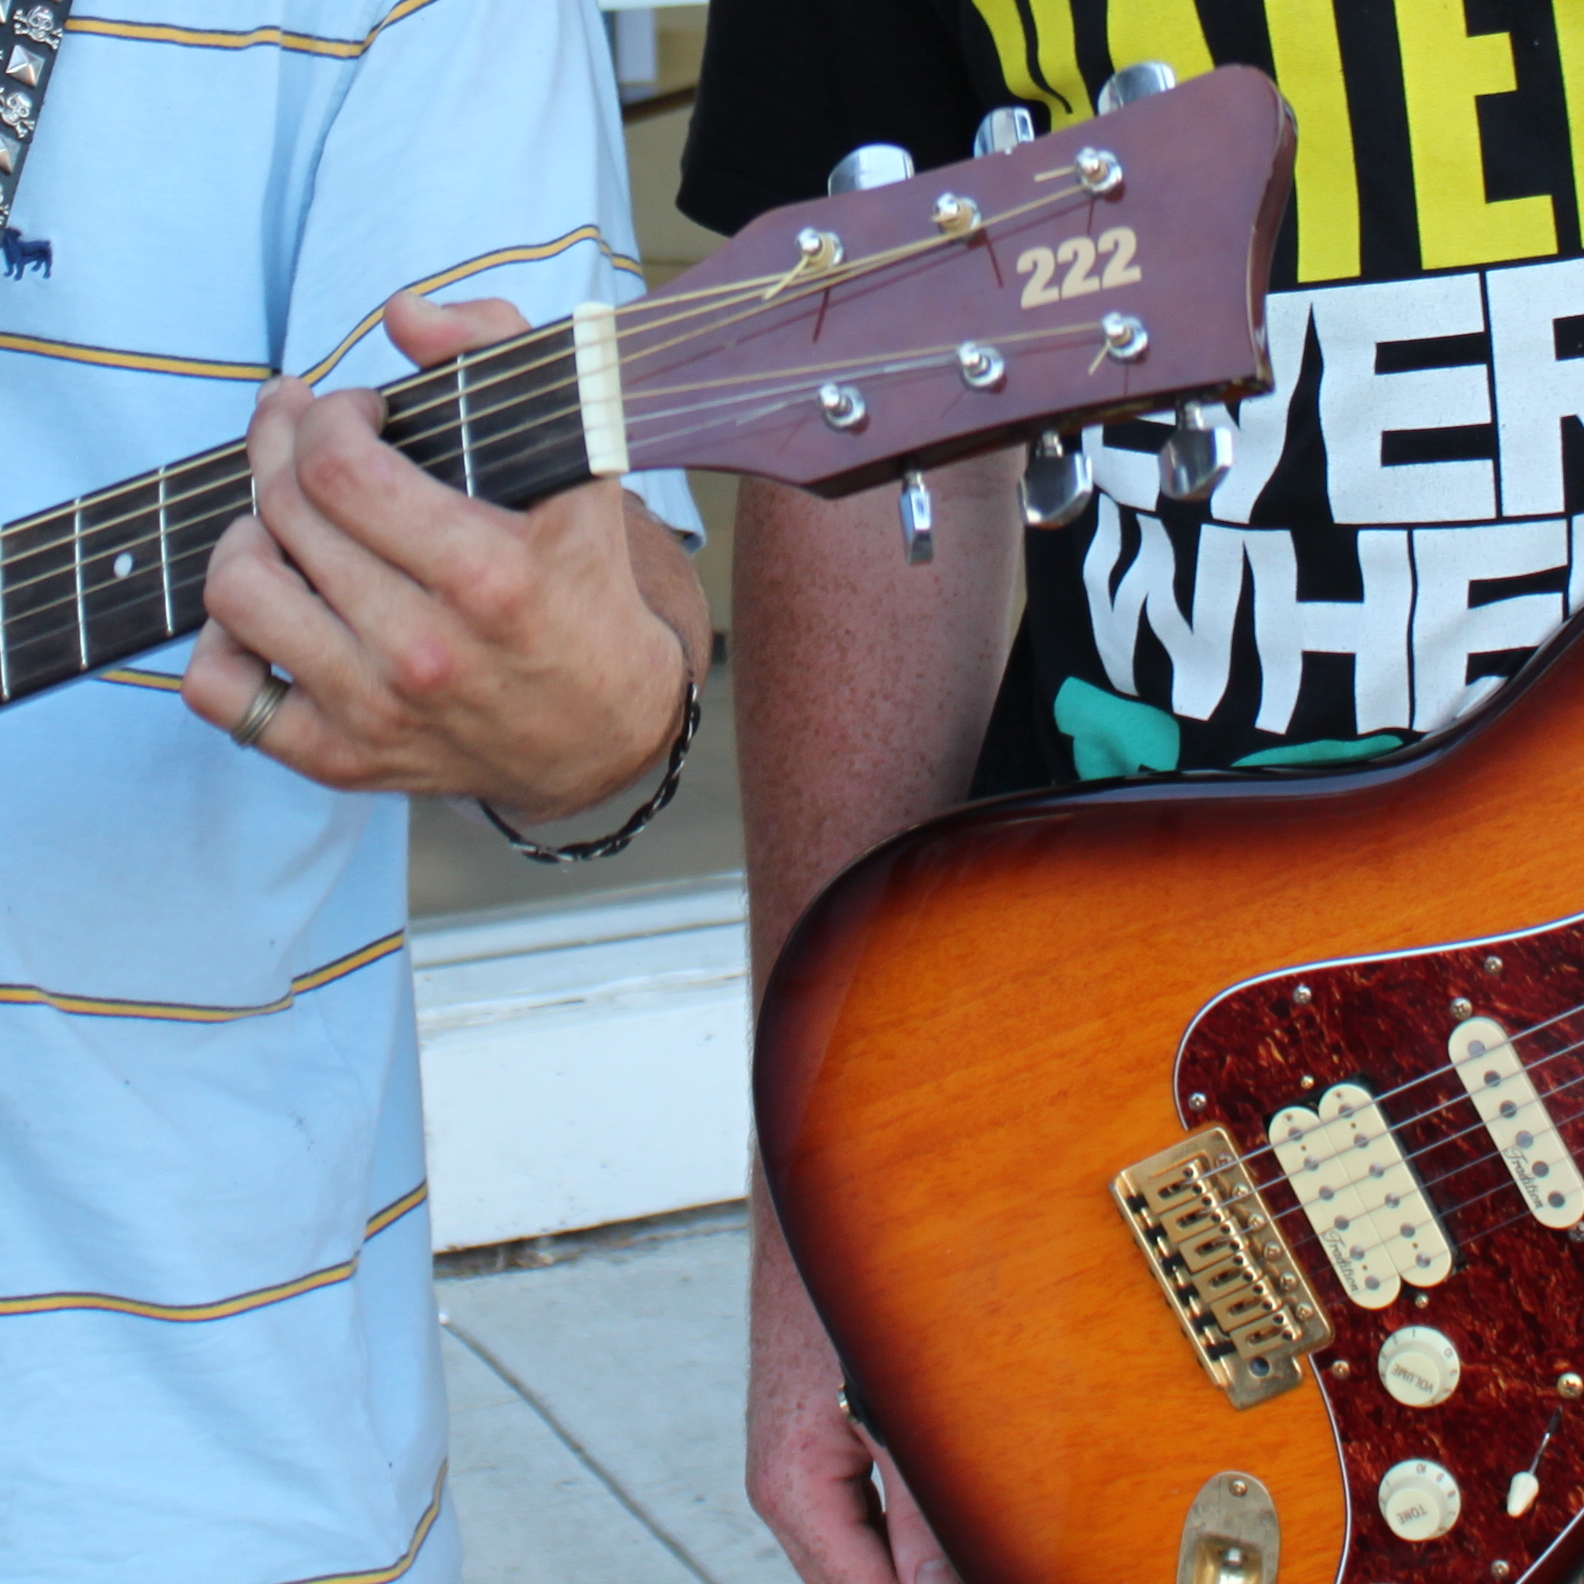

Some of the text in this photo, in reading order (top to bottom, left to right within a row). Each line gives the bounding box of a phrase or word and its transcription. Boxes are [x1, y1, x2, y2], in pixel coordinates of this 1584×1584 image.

[1016, 226, 1142, 310] 222
[1501, 1147, 1543, 1209] Tradition
[1320, 1230, 1359, 1292] Tradition
[1391, 1362, 1434, 1394] VOLUME
[1397, 1503, 1428, 1525] TONE
